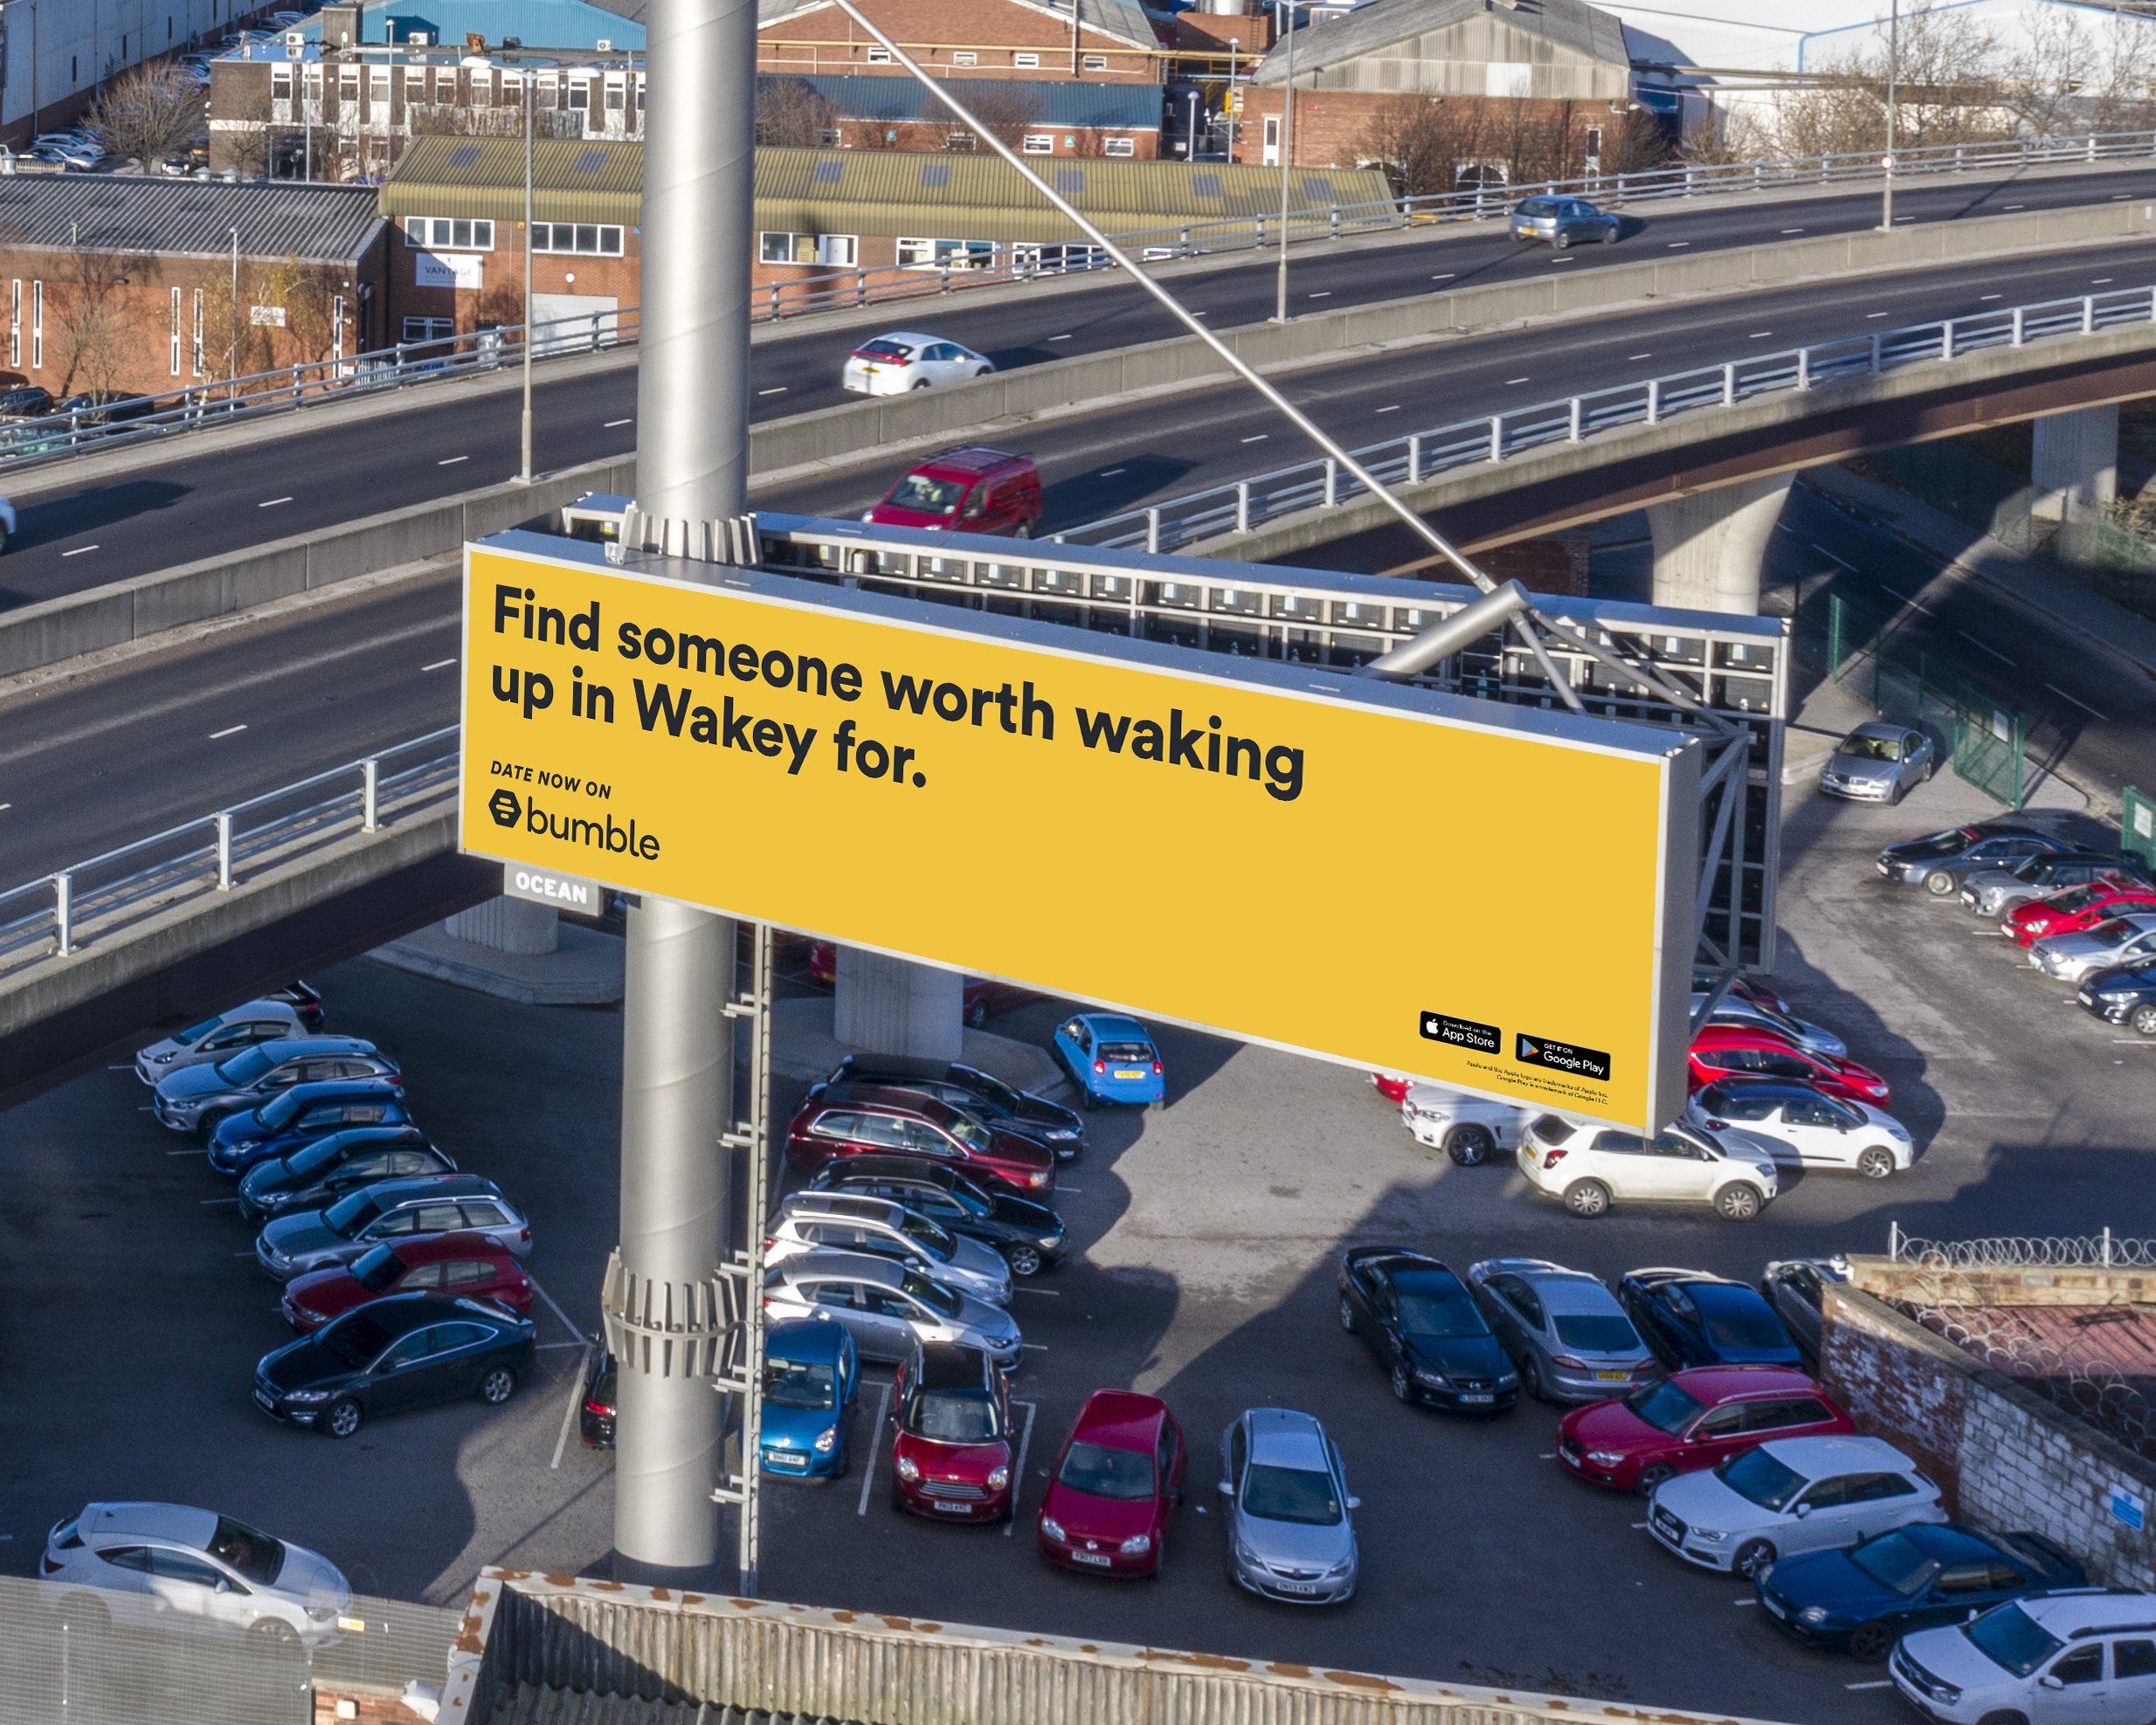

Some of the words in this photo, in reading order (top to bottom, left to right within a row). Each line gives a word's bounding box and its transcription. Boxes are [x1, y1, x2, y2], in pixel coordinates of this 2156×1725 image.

[494, 583, 600, 652] Find
[617, 622, 863, 702] someone
[880, 680, 1054, 741] worth
[1075, 707, 1304, 802] waking
[492, 664, 554, 721] up
[571, 665, 614, 724] in
[632, 678, 819, 776] Wakey
[833, 719, 927, 789] for.
[490, 760, 534, 783] DATE
[537, 770, 582, 792] NOW
[585, 781, 612, 800] ON
[527, 795, 660, 861] bumble
[515, 872, 587, 905] OCEAN
[1442, 1019, 1472, 1032] Download
[1442, 1027, 1465, 1043] App
[1466, 1032, 1496, 1048] Store
[1543, 1050, 1582, 1070] Google
[1582, 1059, 1605, 1076] Play
